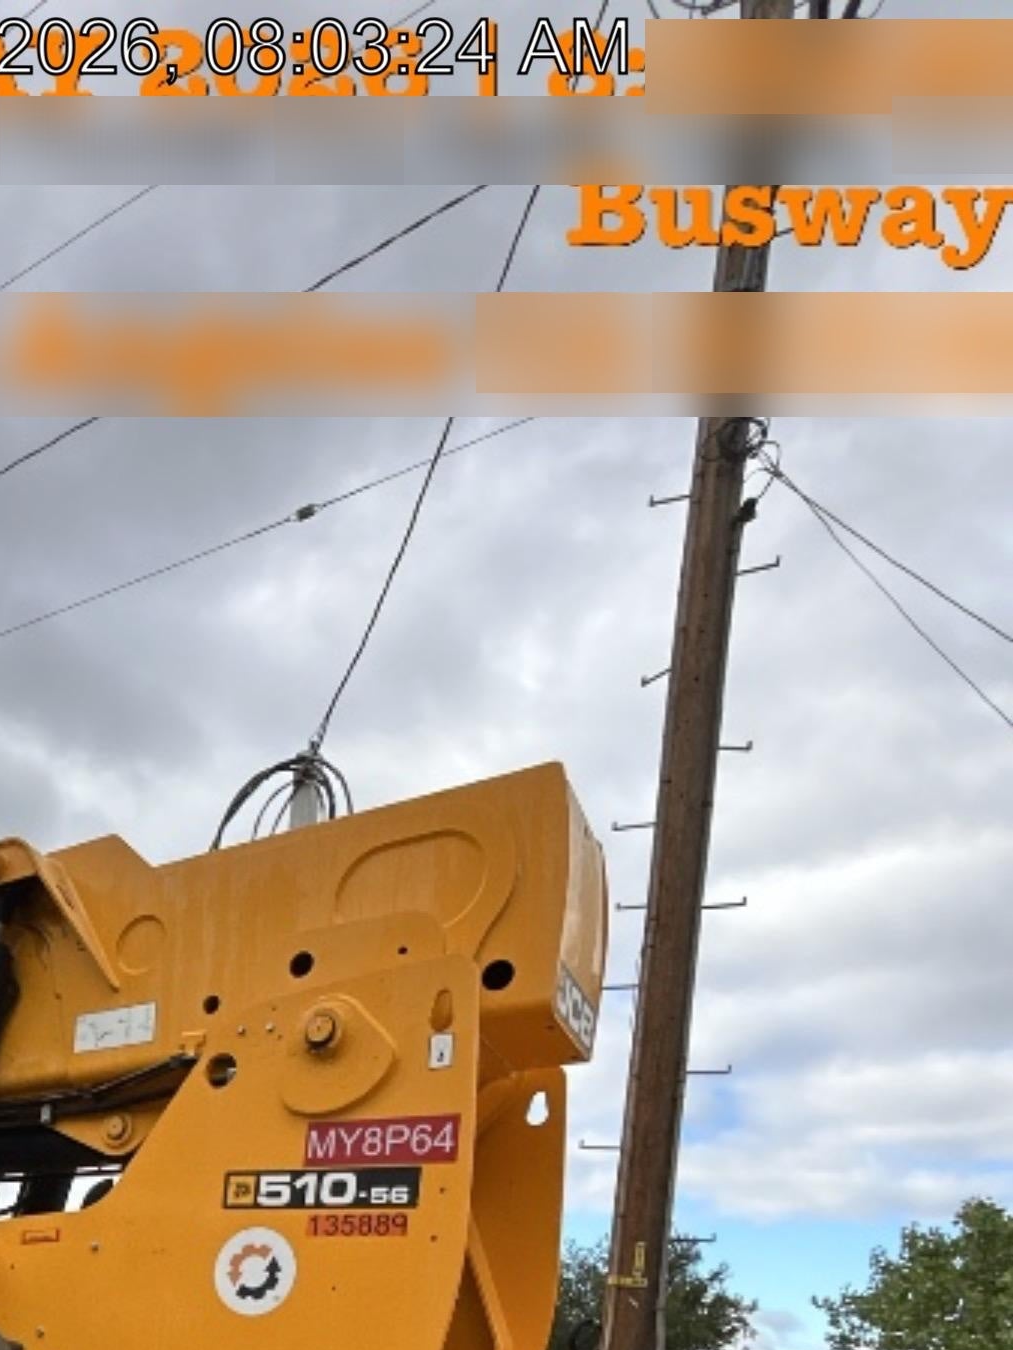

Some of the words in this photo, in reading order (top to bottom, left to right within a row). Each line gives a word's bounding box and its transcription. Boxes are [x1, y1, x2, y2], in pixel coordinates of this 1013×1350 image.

[307, 1121, 455, 1159] MY8P64
[256, 1172, 410, 1206] 510-56
[309, 1213, 409, 1237] 135889
